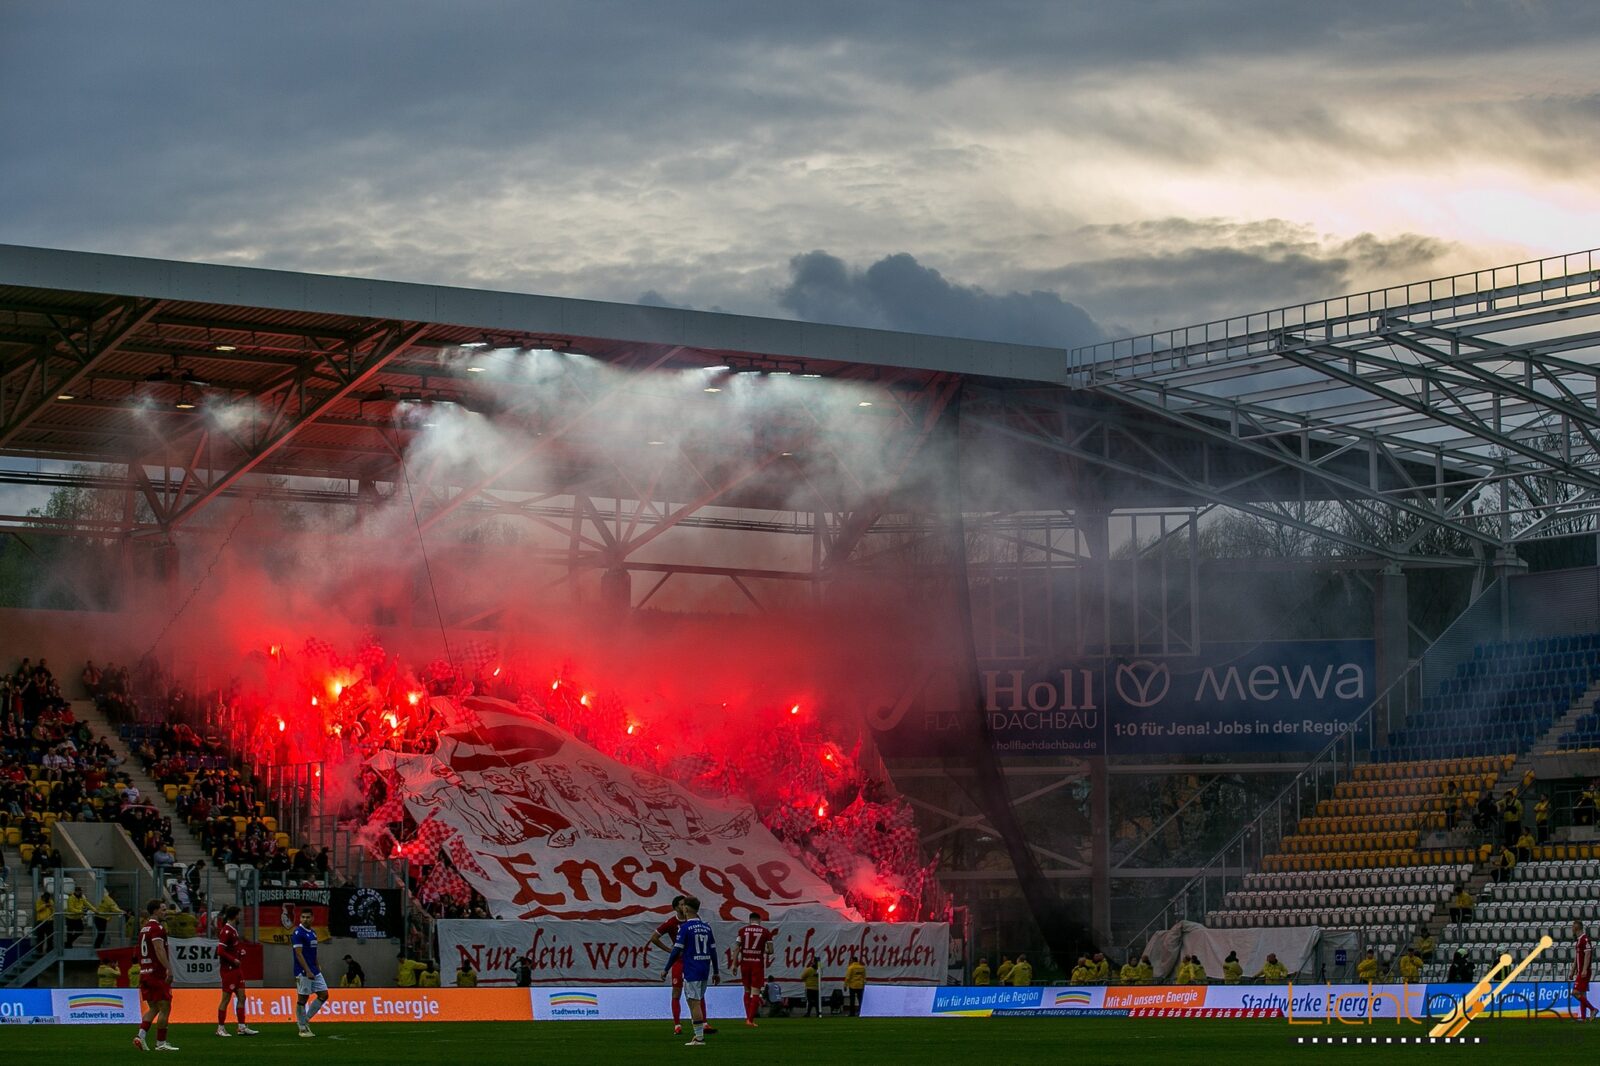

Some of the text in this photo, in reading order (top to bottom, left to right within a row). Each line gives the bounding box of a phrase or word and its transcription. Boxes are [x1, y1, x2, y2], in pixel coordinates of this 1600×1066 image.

[983, 669, 1097, 711] Holl
[925, 712, 1097, 730] FLADACHBAU
[1114, 718, 1362, 737] 1:0 für Jena! Jobs in der Region.
[477, 846, 804, 921] Energie
[141, 933, 148, 957] 6
[456, 944, 516, 972] Nur
[525, 928, 574, 969] dein
[583, 940, 653, 969] Wort
[785, 928, 816, 968] ich
[824, 926, 937, 968] verkünden
[694, 934, 708, 954] 17
[744, 932, 763, 949] 17
[187, 963, 212, 973] 1990
[271, 996, 292, 1015] all
[373, 995, 440, 1018] Energie
[937, 990, 1039, 1008] Wir für Jena und die Region
[1105, 990, 1198, 1008] Mit all unserer Energie
[1241, 993, 1381, 1016] Stadtwerke Energie
[1428, 994, 1446, 1009] Wir
[1517, 988, 1535, 1003] die
[109, 1011, 125, 1019] jena
[586, 1008, 599, 1016] jena
